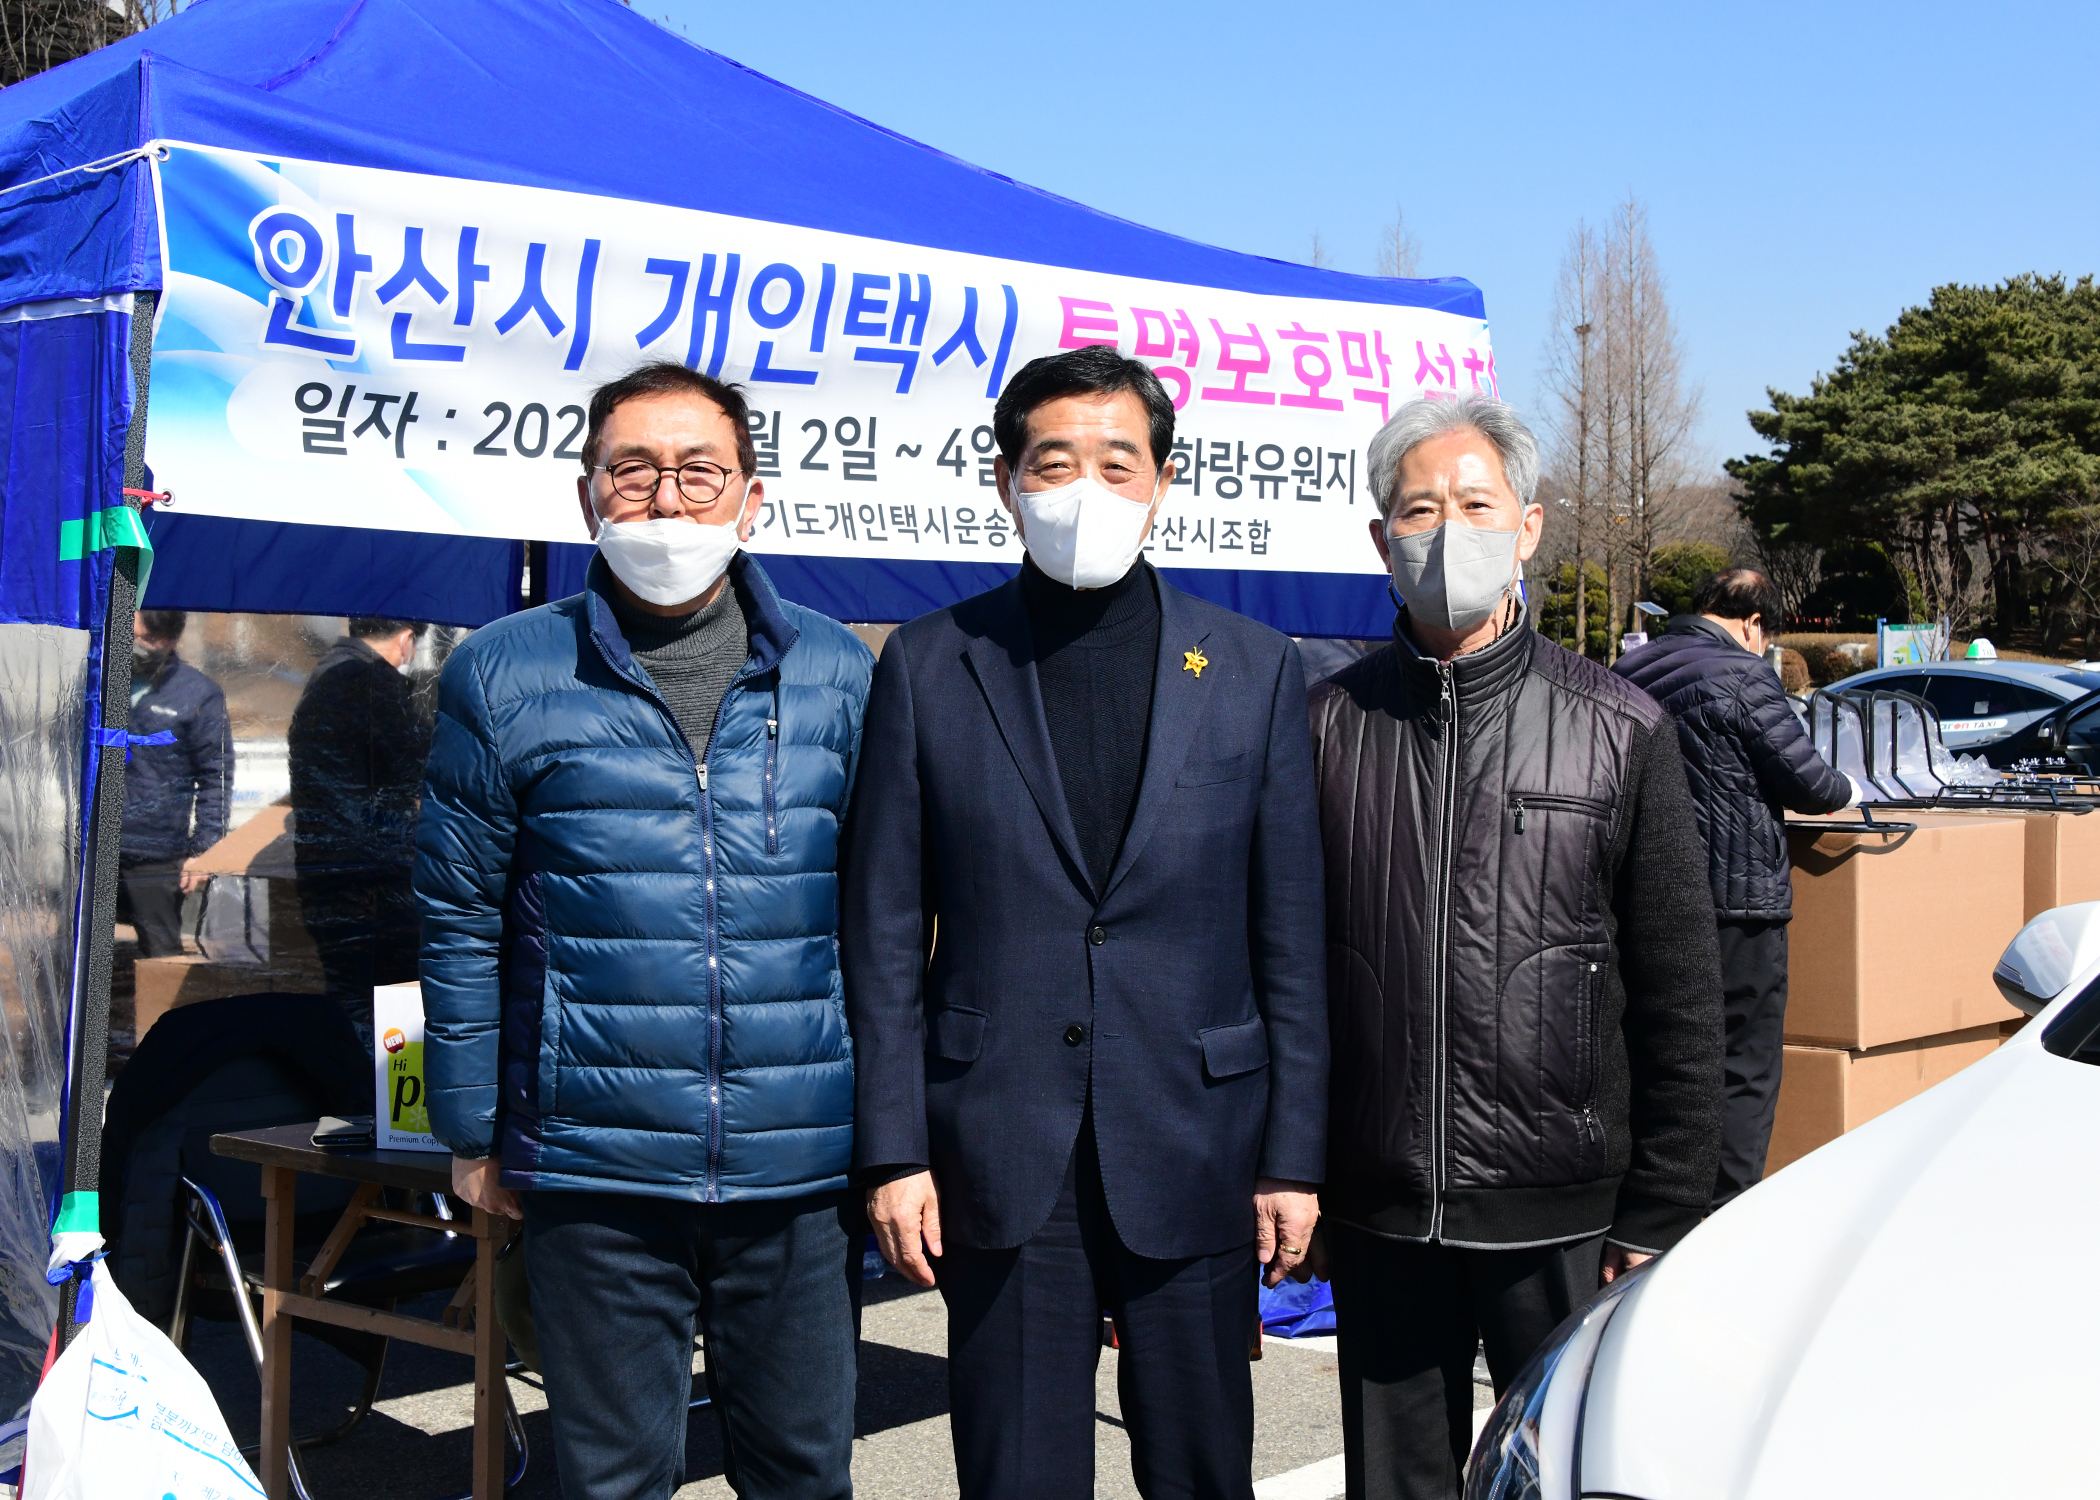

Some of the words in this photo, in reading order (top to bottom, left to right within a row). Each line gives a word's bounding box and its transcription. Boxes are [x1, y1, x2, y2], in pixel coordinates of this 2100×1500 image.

[254, 212, 601, 370] 안산시
[636, 253, 1018, 399] 개인택시
[294, 382, 419, 459] 일자
[437, 409, 457, 451] :
[473, 401, 586, 459] 202
[748, 410, 782, 478] 월
[800, 416, 878, 482] 2일
[895, 443, 923, 458] ~
[1170, 436, 1356, 505] 화랑유원지
[749, 499, 1020, 547] 기도개인택시운송
[1974, 720, 1997, 729] TAXI
[385, 1033, 403, 1049] NEW
[393, 1059, 407, 1072] Hi
[392, 1075, 427, 1122] p
[388, 1135, 419, 1144] Premium
